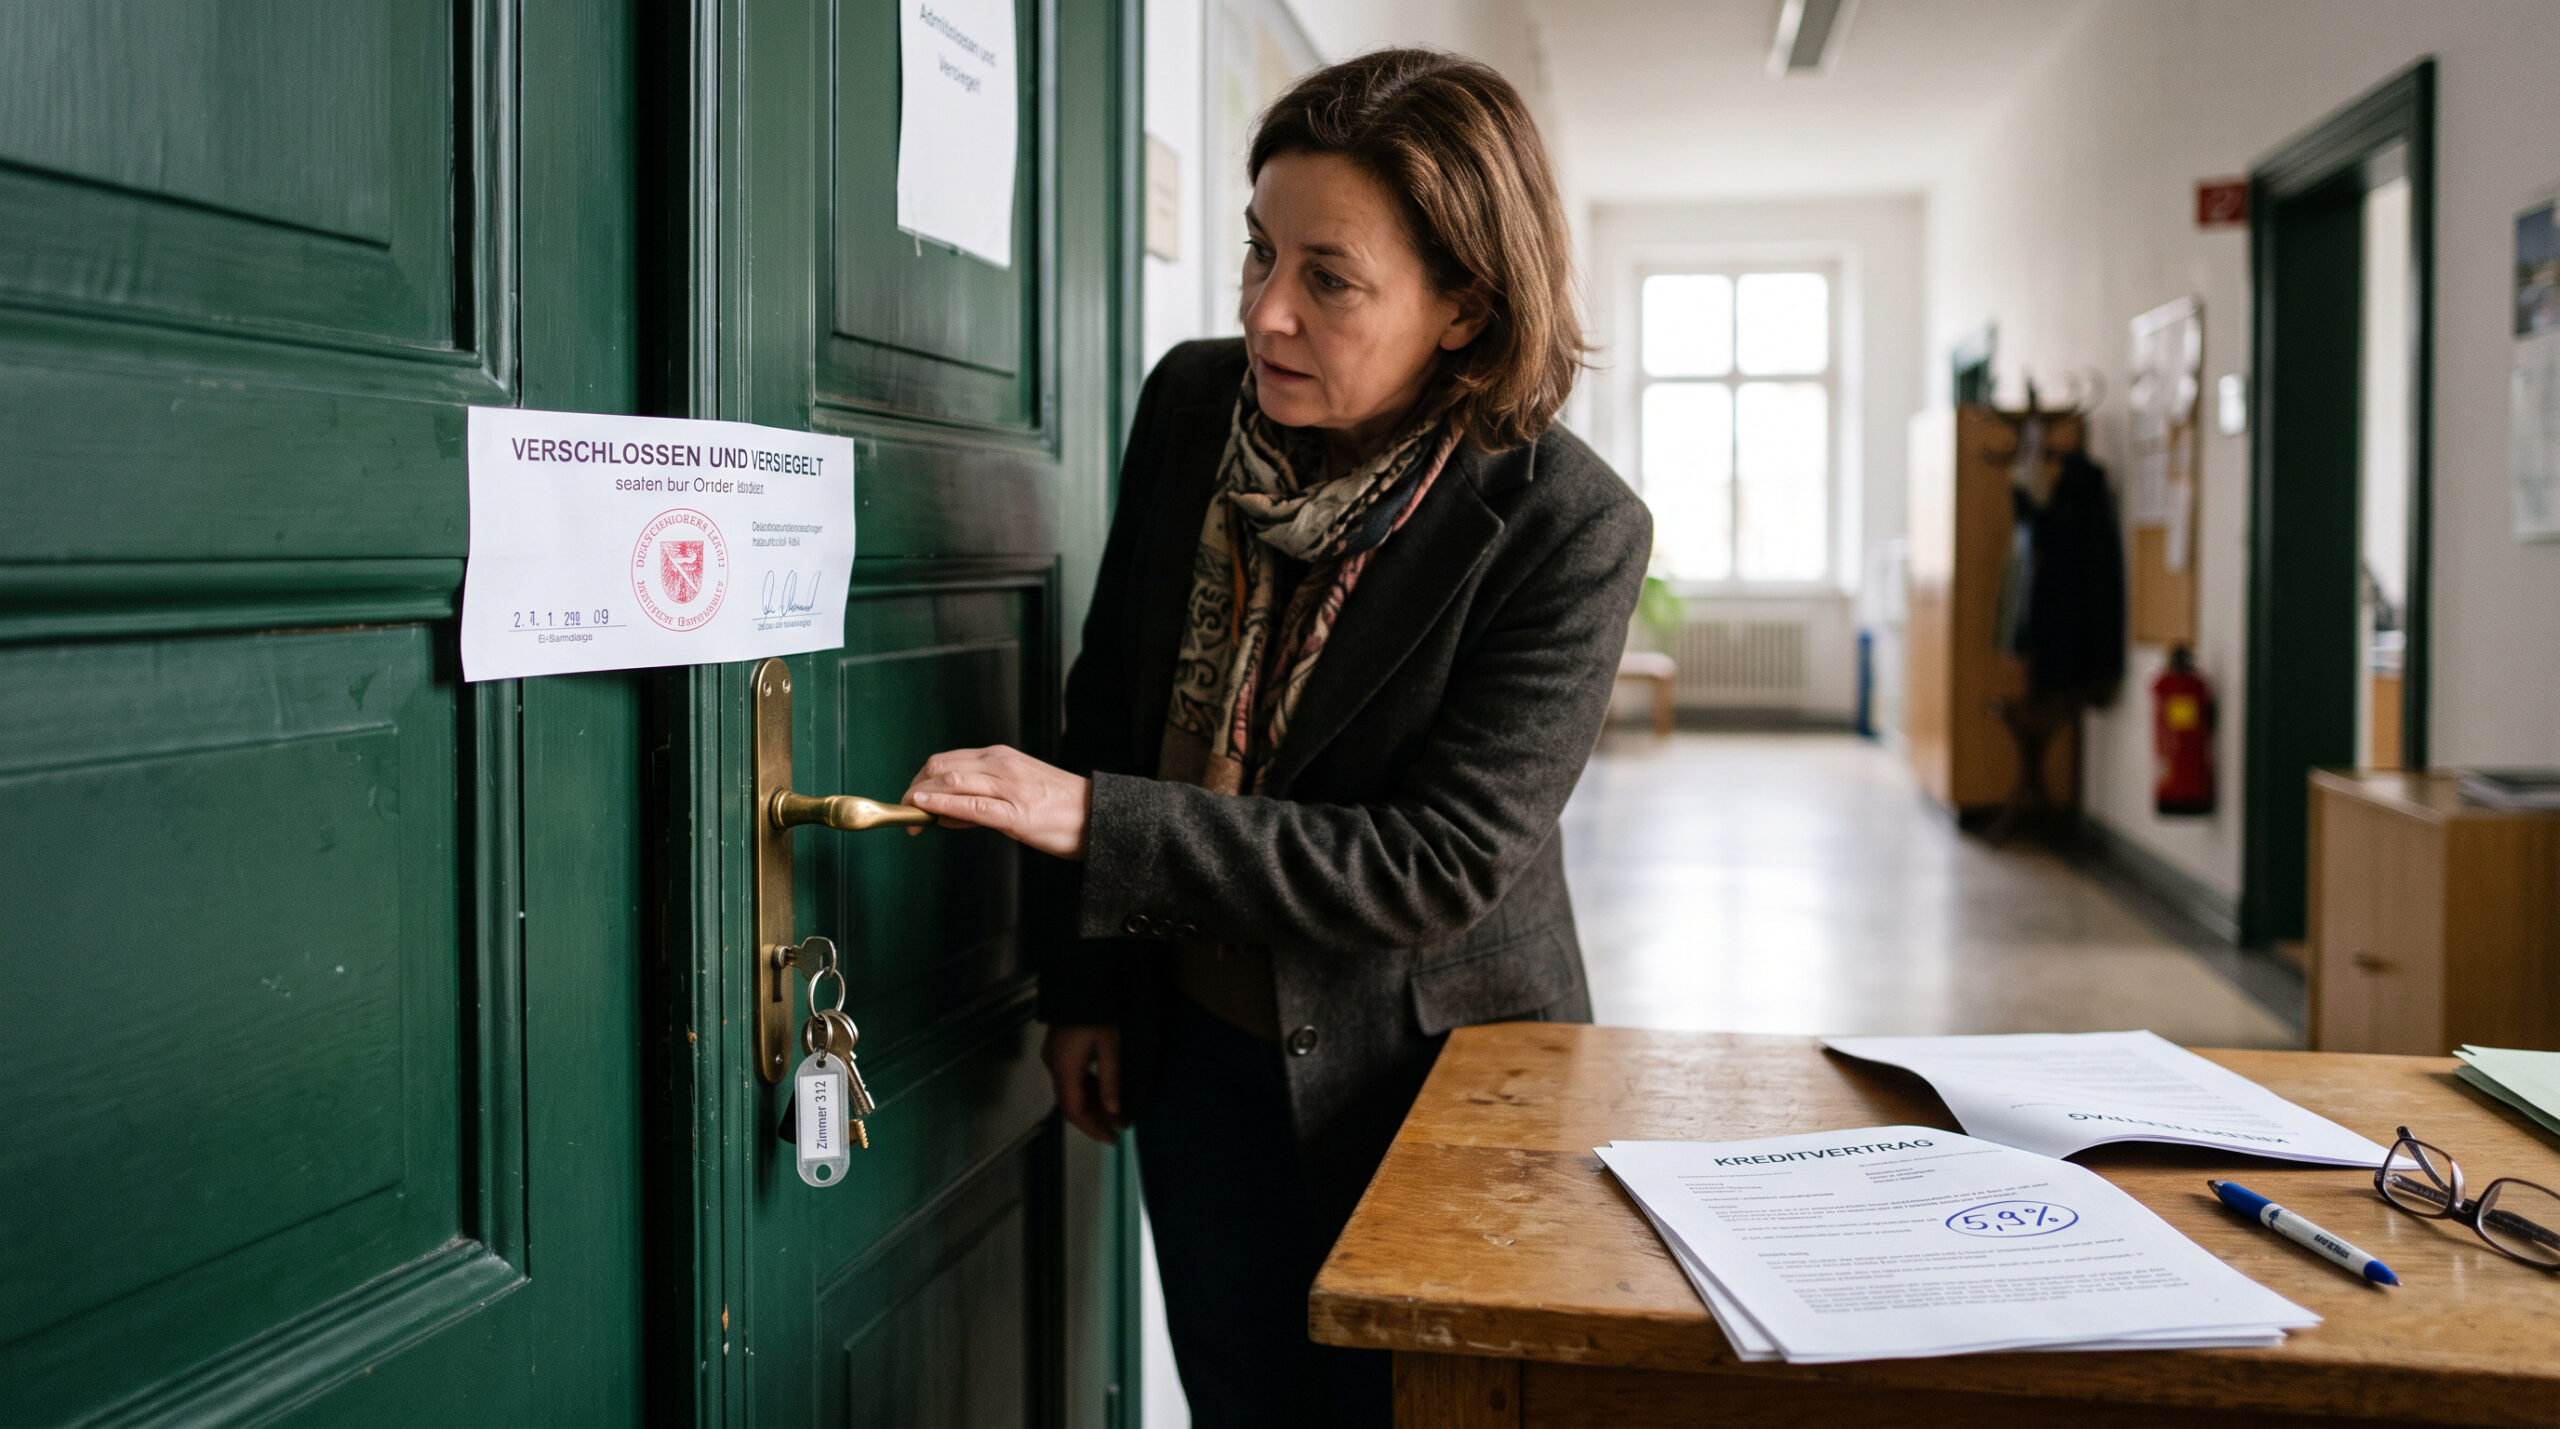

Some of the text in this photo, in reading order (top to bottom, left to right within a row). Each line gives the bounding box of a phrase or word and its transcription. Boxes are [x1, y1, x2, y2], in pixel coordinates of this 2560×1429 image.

[512, 438, 824, 477] VERSCHLOSSEN UND VERSIEGELT
[667, 477, 690, 492] bur
[593, 608, 609, 625] 09
[814, 1080, 828, 1150] Zimmer 312
[1714, 1138, 1935, 1167] KREDITVERTRAG
[1963, 1205, 2060, 1232] 5,9%
